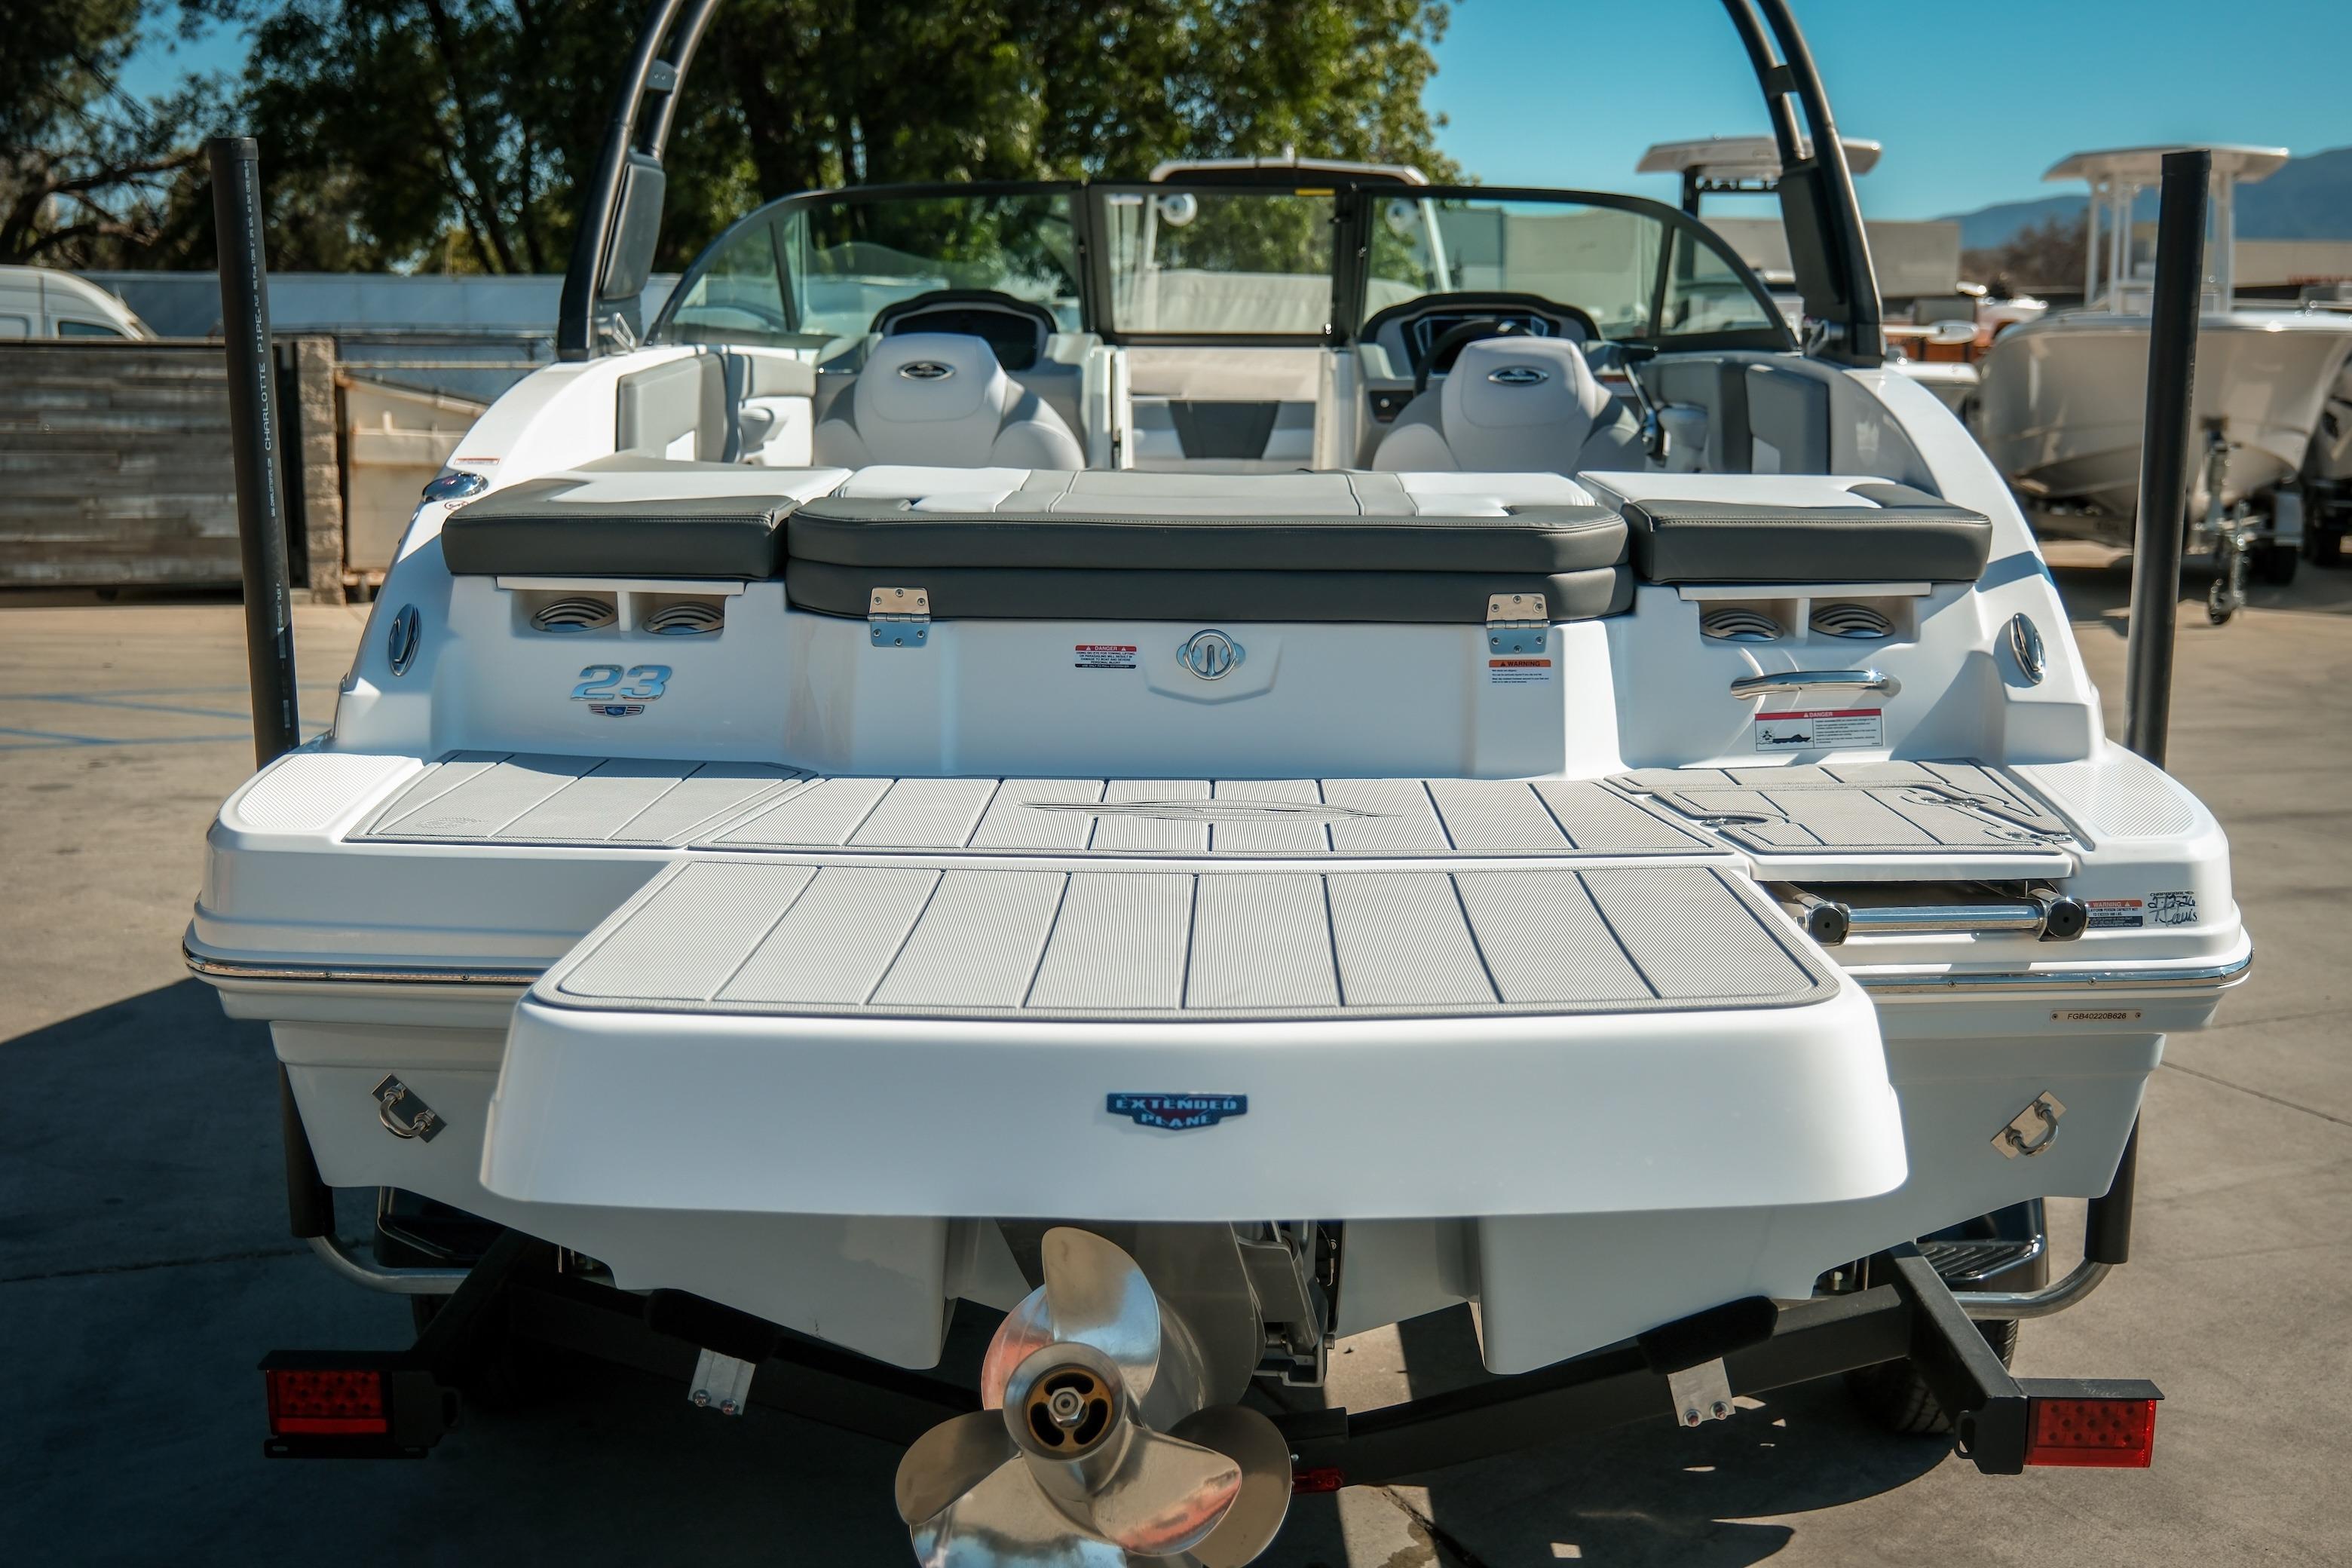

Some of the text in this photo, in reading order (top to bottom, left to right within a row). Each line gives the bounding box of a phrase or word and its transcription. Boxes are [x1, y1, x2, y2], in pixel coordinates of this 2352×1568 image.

[259, 363, 271, 451] CHARLOTTE
[570, 664, 672, 702] 23
[1116, 1099, 1237, 1110] EXTENDED
[1141, 1113, 1212, 1127] PLANE
